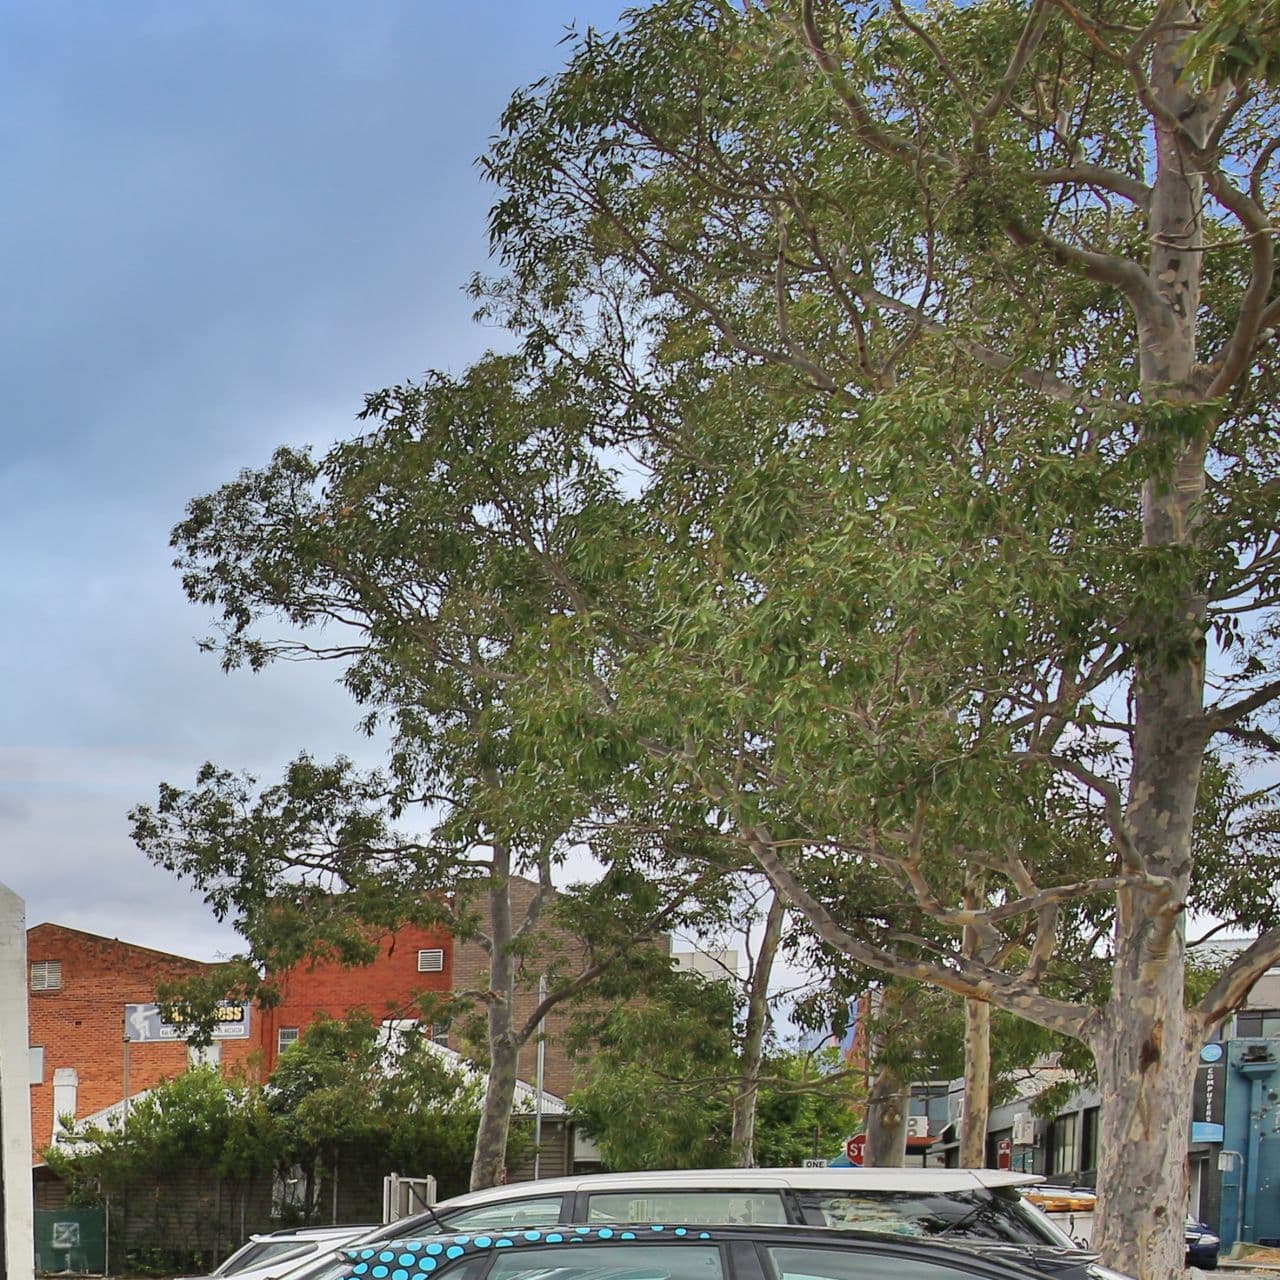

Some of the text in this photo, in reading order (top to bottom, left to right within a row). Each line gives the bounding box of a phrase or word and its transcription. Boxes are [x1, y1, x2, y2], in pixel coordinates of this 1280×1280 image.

[1206, 1067, 1214, 1122] COMPUTERS
[850, 1143, 866, 1156] ST
[806, 1160, 824, 1168] ONE
